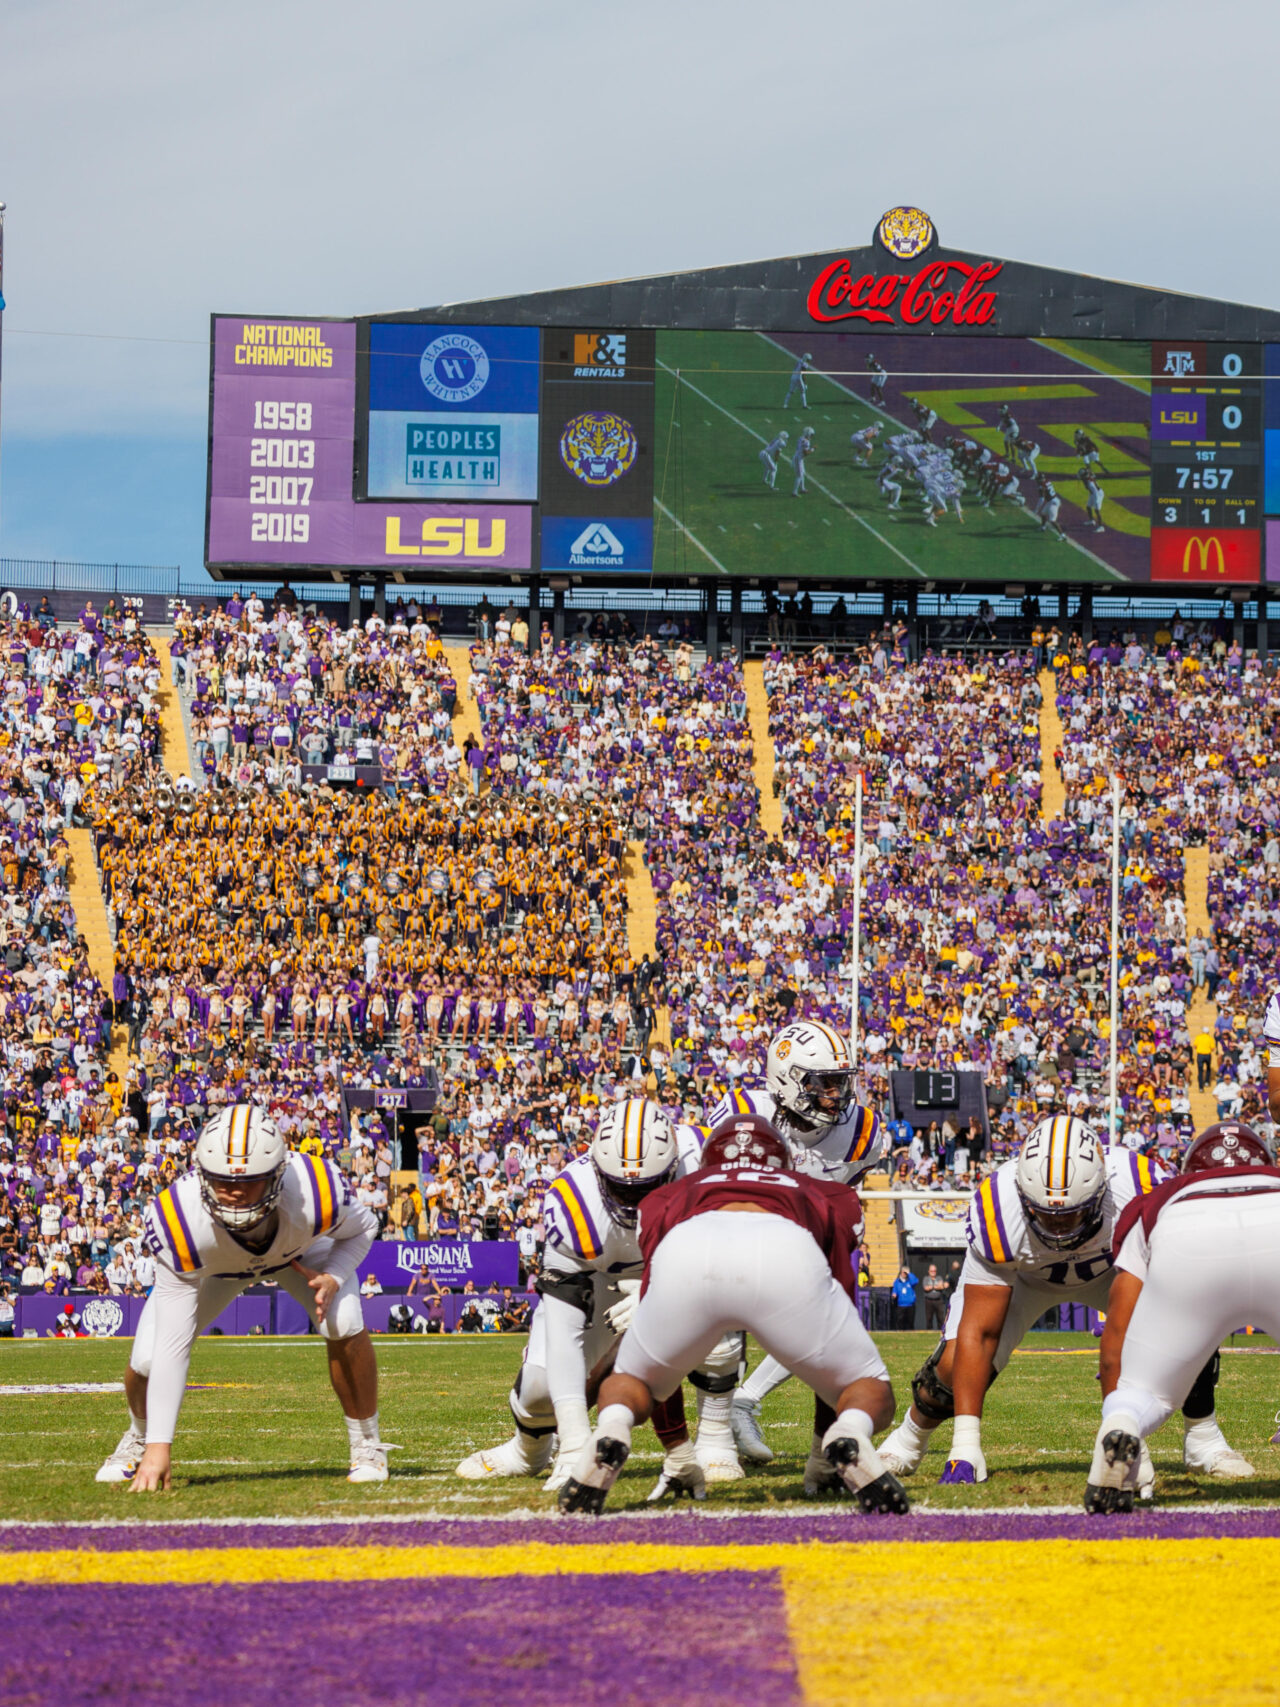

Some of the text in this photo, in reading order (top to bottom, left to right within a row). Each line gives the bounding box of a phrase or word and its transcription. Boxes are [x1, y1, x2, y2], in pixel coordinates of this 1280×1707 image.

[807, 258, 1003, 324] Coca-Cola
[243, 324, 326, 347] NATIONAL
[234, 345, 333, 368] CHAMPIONS
[424, 336, 486, 364] HANCOCK
[573, 367, 625, 378] RENTALS
[1222, 353, 1242, 377] 0
[423, 372, 486, 400] WHITNEY
[254, 400, 312, 431] 1958
[1160, 410, 1198, 424] LSU
[1222, 405, 1242, 430] 0
[413, 429, 495, 450] PEOPLES
[250, 438, 315, 469] 2003
[1195, 451, 1216, 461] 1ST
[412, 460, 495, 480] HEALTH
[1176, 468, 1234, 490] 7:57
[249, 475, 314, 506] 2007
[1164, 506, 1177, 523] 3
[1201, 508, 1210, 524] 1
[1237, 509, 1245, 525] 1
[251, 512, 310, 543] 2019
[385, 516, 506, 557] LSU
[569, 554, 624, 566] Albertsons
[929, 1073, 955, 1101] 13
[381, 1094, 402, 1106] 217
[396, 1243, 474, 1274] LOUISIANA
